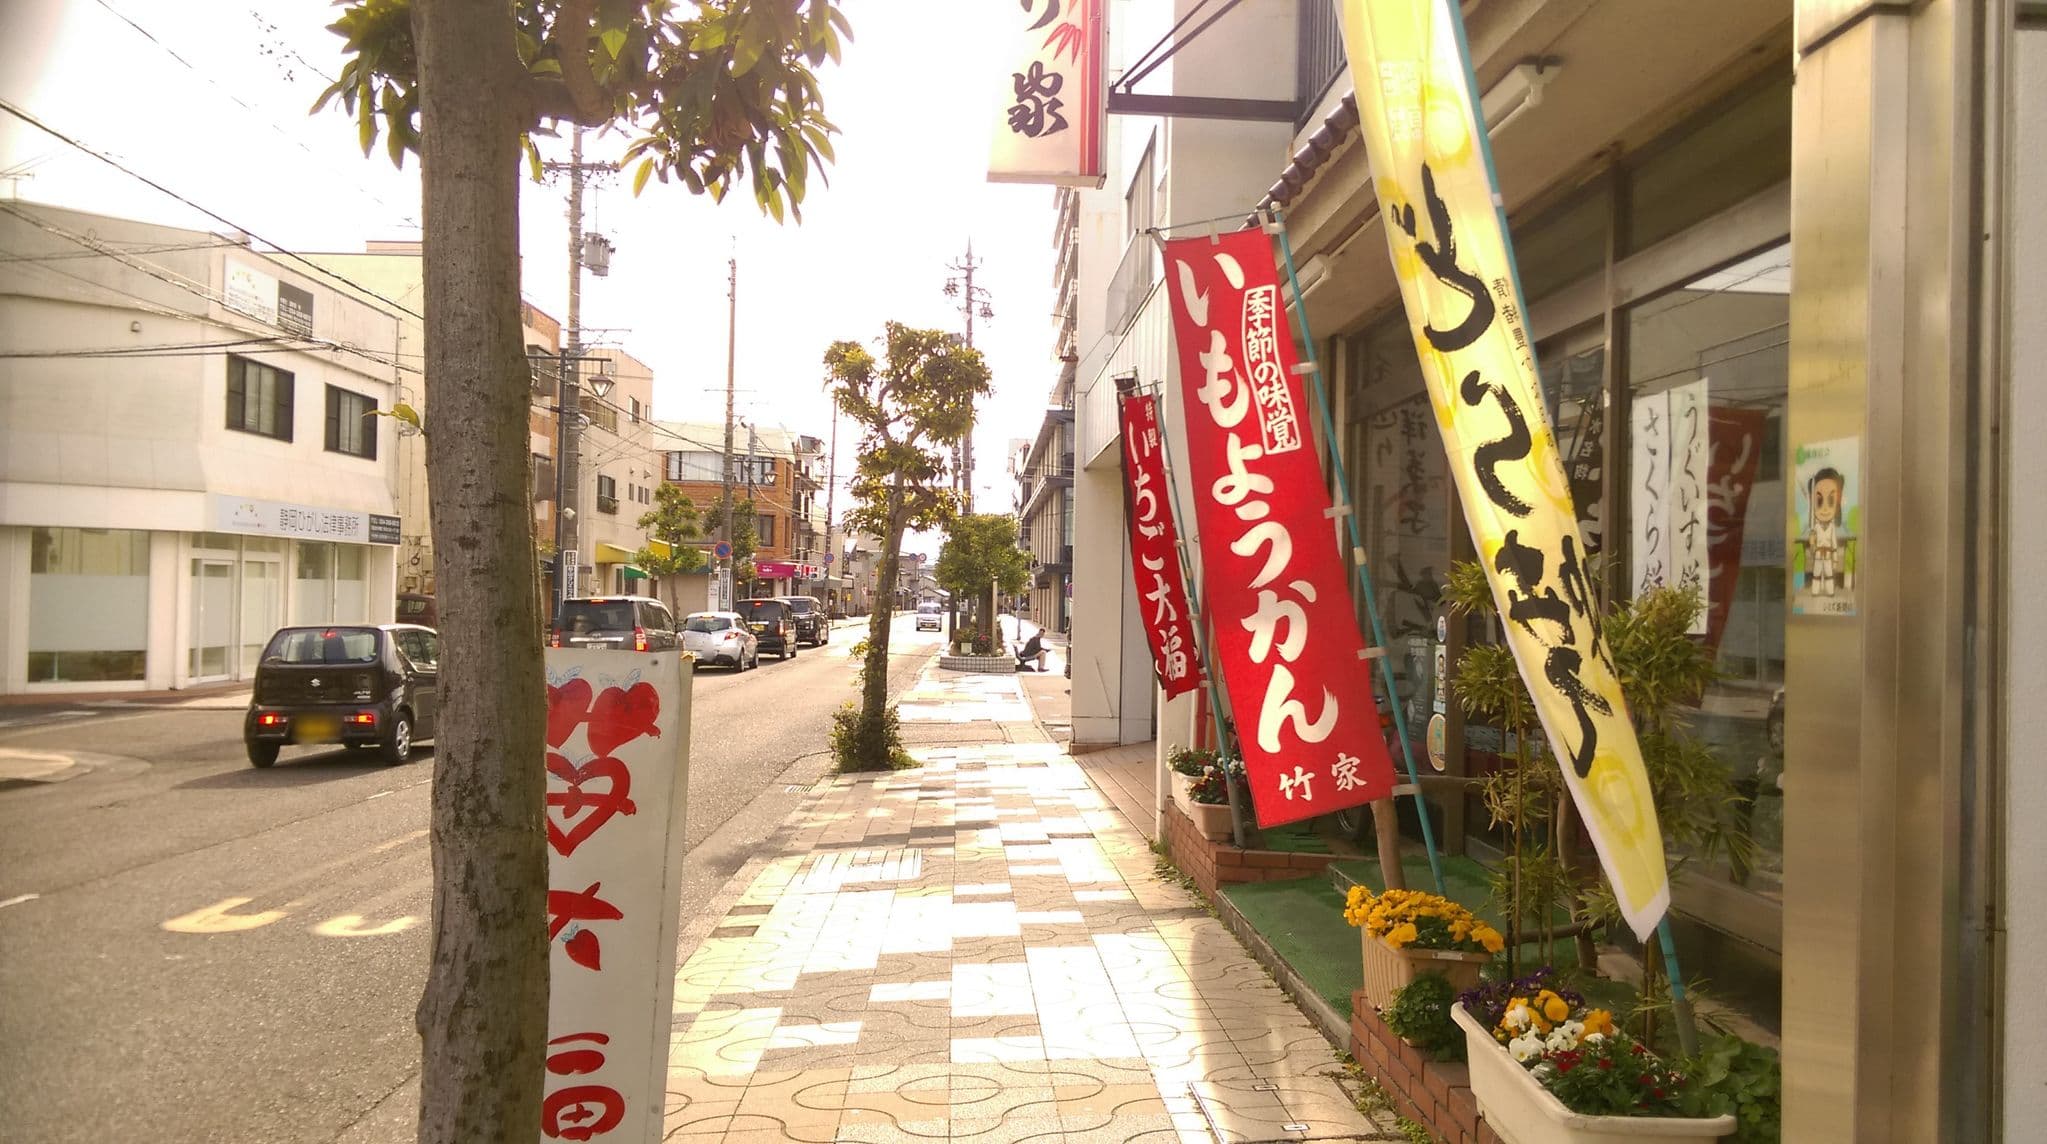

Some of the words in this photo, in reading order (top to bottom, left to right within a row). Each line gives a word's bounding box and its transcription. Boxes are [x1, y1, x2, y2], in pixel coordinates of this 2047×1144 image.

[1248, 288, 1297, 449] 季節の味覚
[1128, 421, 1188, 682] いちご大福
[1176, 253, 1339, 753] いもようかん
[1279, 752, 1368, 801] 竹家
